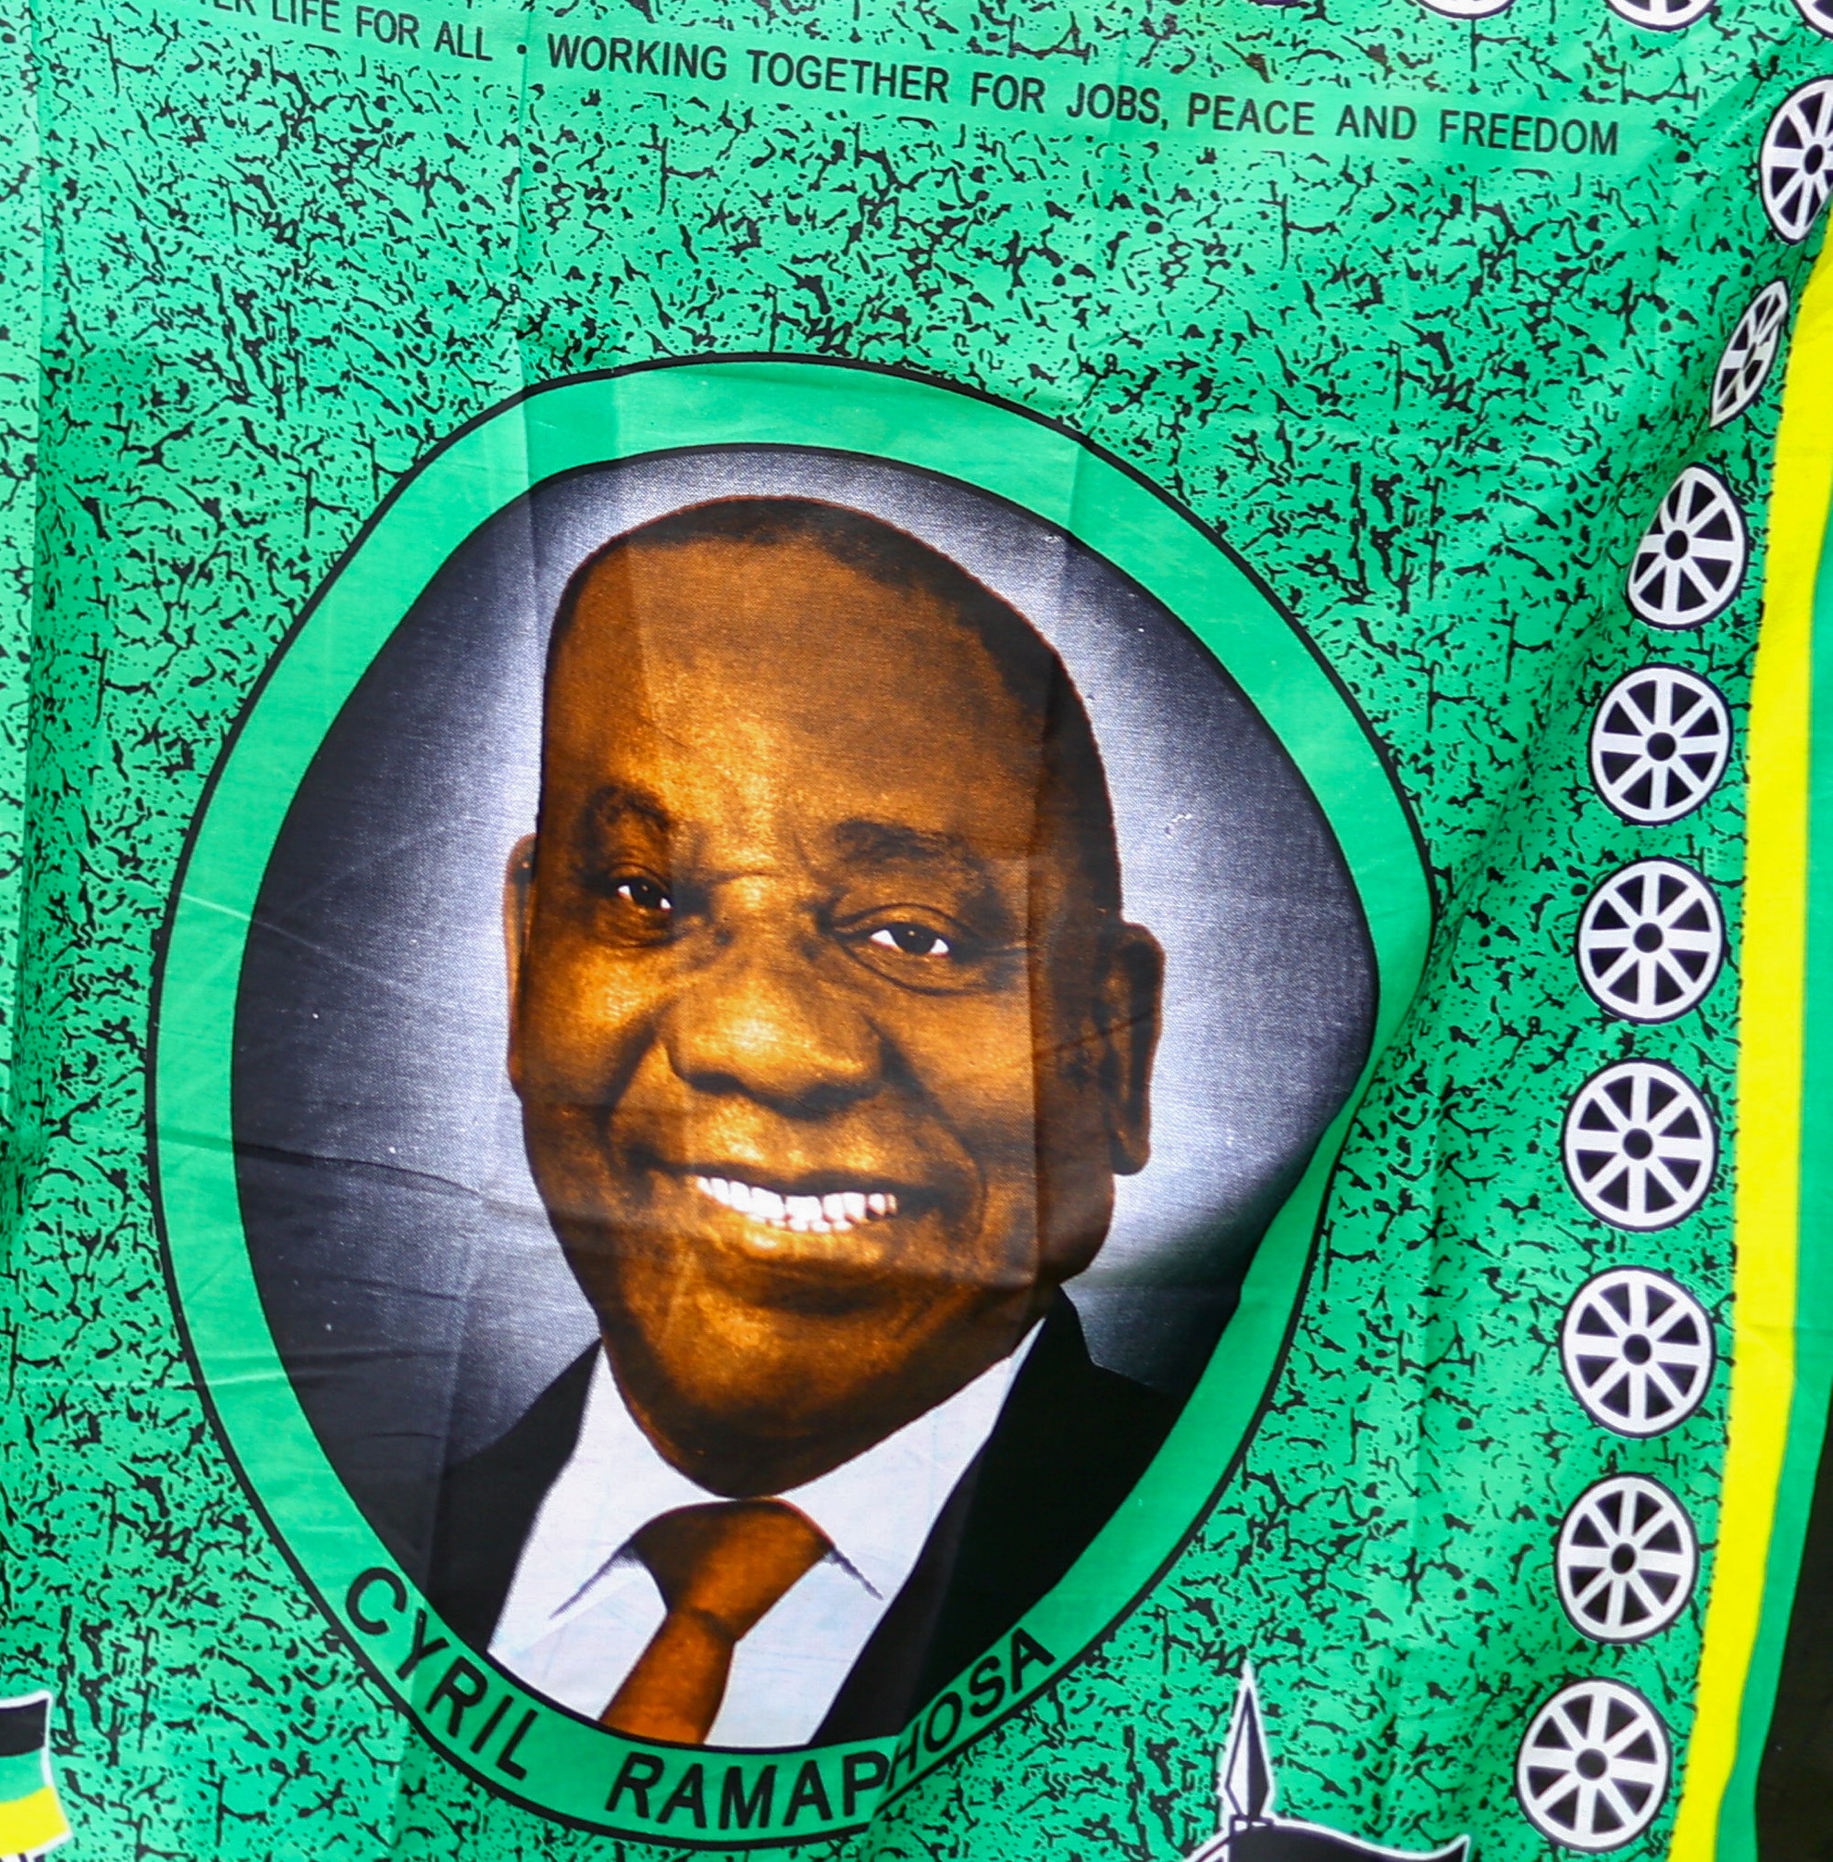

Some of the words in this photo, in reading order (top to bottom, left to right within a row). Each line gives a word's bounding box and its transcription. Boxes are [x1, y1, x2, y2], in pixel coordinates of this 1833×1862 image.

[356, 9, 420, 48] FOR
[434, 21, 493, 62] ALL
[547, 34, 727, 81] WORKING
[747, 50, 948, 103] TOGETHER
[970, 71, 1046, 115] FOR
[1065, 82, 1169, 132] JOBS,
[1187, 95, 1314, 137] PEACE
[1334, 102, 1417, 143] AND
[1439, 108, 1619, 156] FREEDOM
[344, 1566, 538, 1782] CYRIL
[604, 1627, 1058, 1831] RAMAPHOSA
